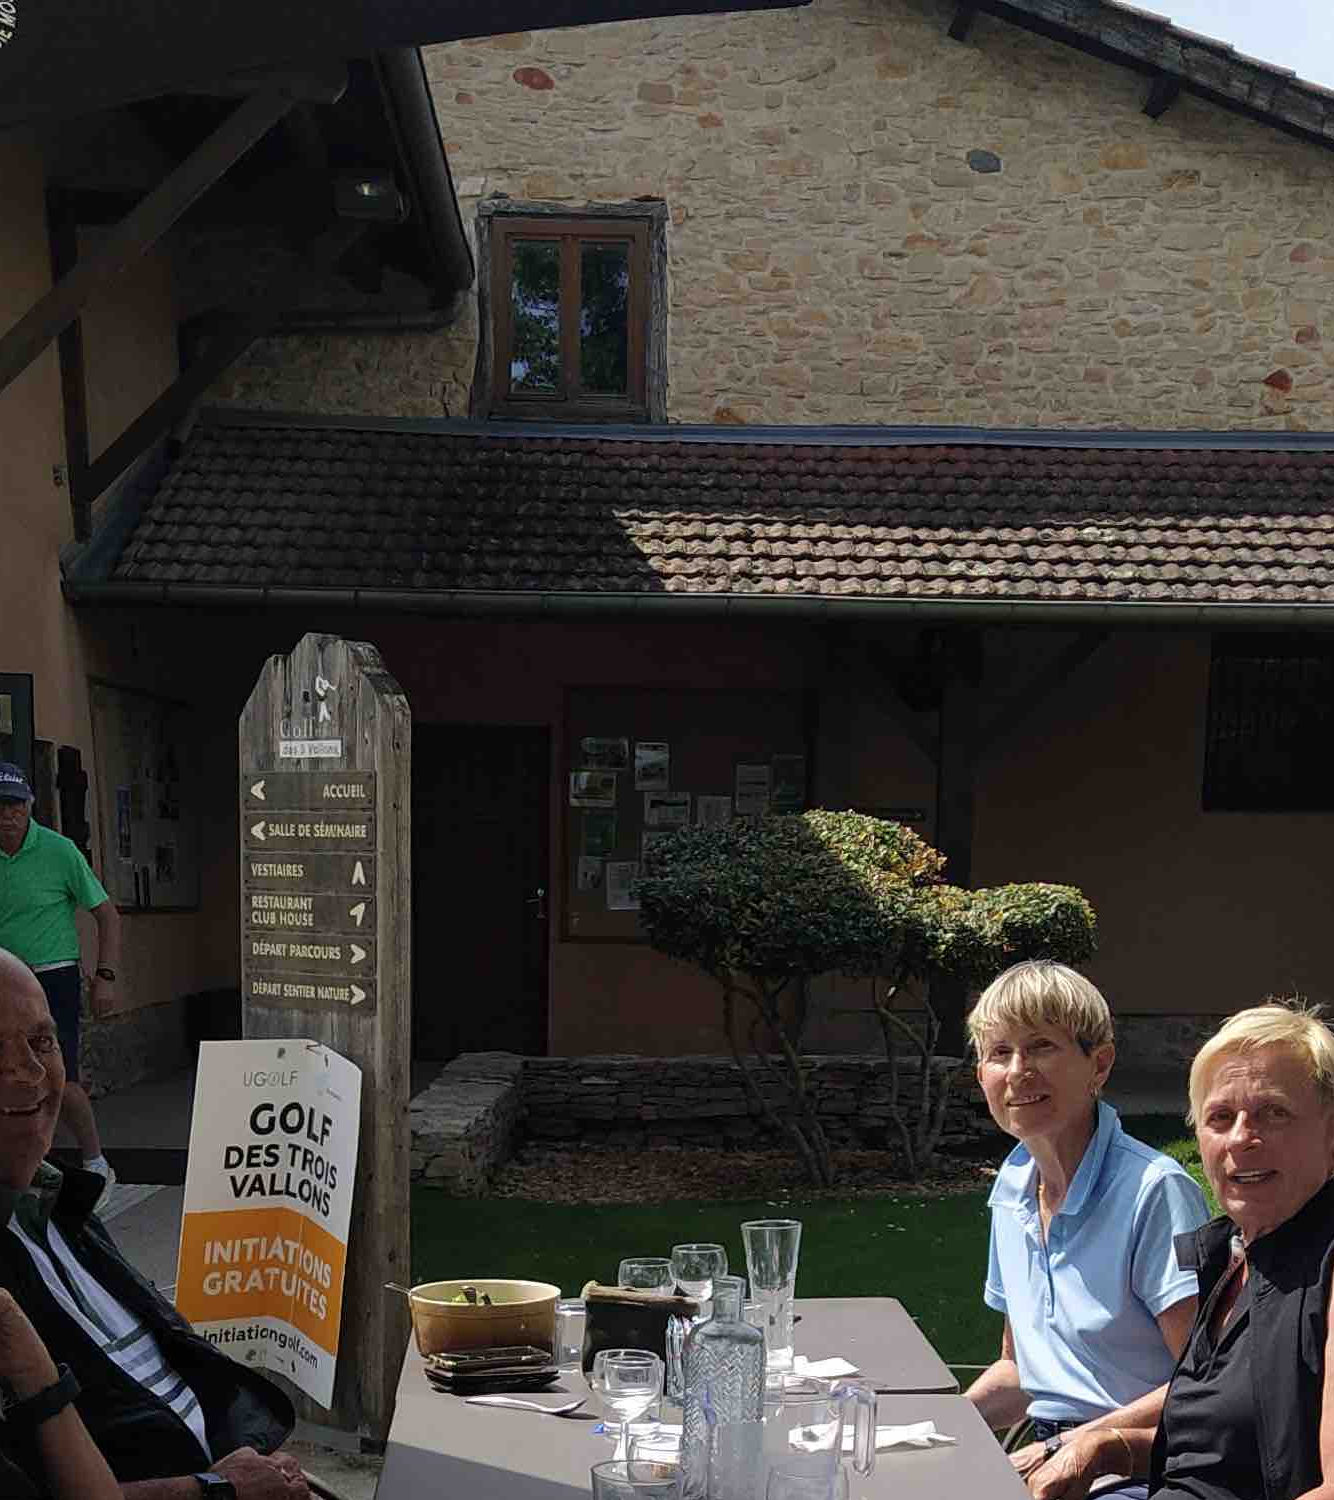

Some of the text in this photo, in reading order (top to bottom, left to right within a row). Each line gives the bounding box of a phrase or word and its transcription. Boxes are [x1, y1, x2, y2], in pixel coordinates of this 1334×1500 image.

[322, 783, 366, 799] ACCUEIL
[268, 818, 367, 839] SALLE DE SÉMINAIRE
[250, 862, 304, 878] VESTIAIRES
[251, 895, 314, 911] RESTAURANT
[251, 911, 315, 928] CLUB HOUSE
[252, 938, 342, 960] DÉPART PARCOURS
[252, 976, 350, 1002] DÉPART SENTIER NATURE
[242, 1070, 299, 1087] UGOLF
[249, 1101, 333, 1147] GOLF
[223, 1142, 338, 1190] DES TROIS
[229, 1172, 331, 1218] VALLONS
[203, 1232, 332, 1290] INITIATIONS
[202, 1266, 328, 1321] GRATUITES
[203, 1324, 319, 1369] initiationgolf.com
